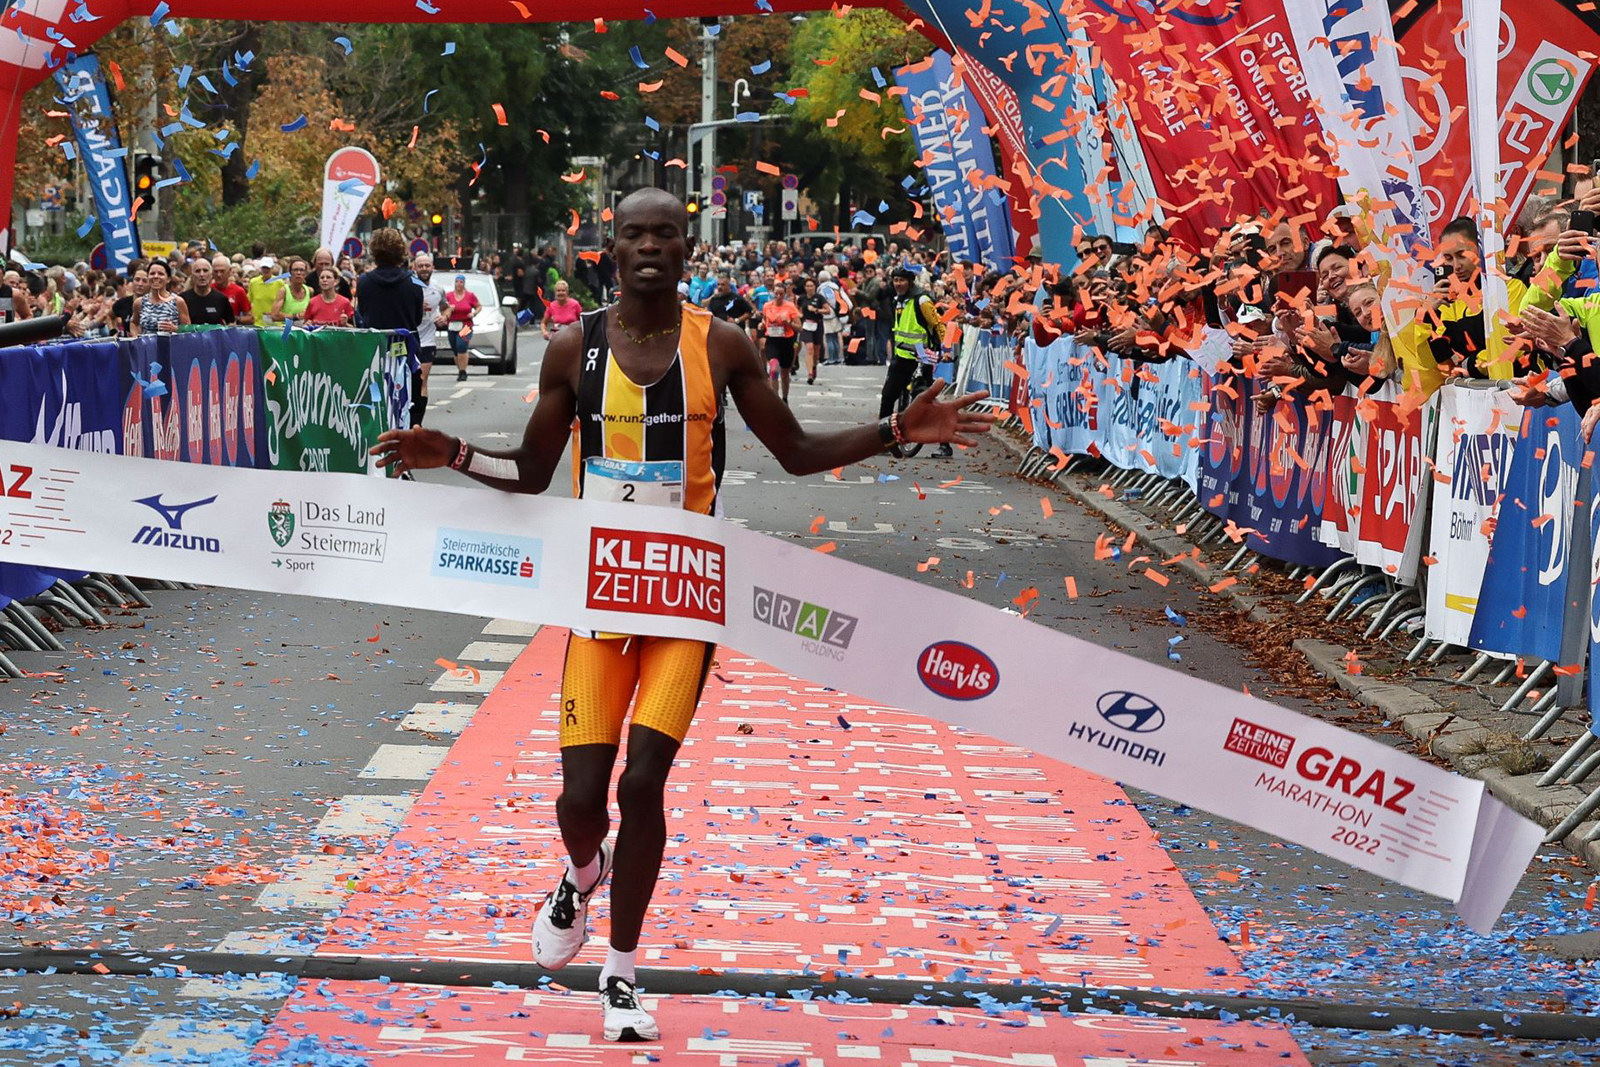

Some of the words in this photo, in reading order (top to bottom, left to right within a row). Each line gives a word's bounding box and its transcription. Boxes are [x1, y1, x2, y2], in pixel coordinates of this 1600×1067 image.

[1264, 31, 1311, 102] STORE
[591, 412, 707, 426] www.run2gether.com
[622, 483, 635, 502] 2
[305, 502, 340, 522] Das
[347, 504, 385, 526] Land
[132, 526, 220, 553] MIZUNO
[300, 532, 383, 557] Steiermark
[442, 538, 520, 559] Steiermärkische
[286, 558, 315, 571] Sport
[438, 553, 518, 576] SPARKASSE
[595, 537, 721, 582] KLEINE
[593, 571, 721, 614] ZEITUNG
[754, 593, 851, 645] GRAZ
[800, 640, 845, 662] HOLDING
[924, 648, 991, 690] Hervis
[1069, 722, 1166, 767] HYUNDAI
[1227, 734, 1286, 766] ZEITUNG
[1232, 722, 1292, 752] KLEINE
[1296, 747, 1415, 816] GRAZ
[1255, 772, 1374, 828] MARATHON
[1331, 826, 1381, 856] 2022
